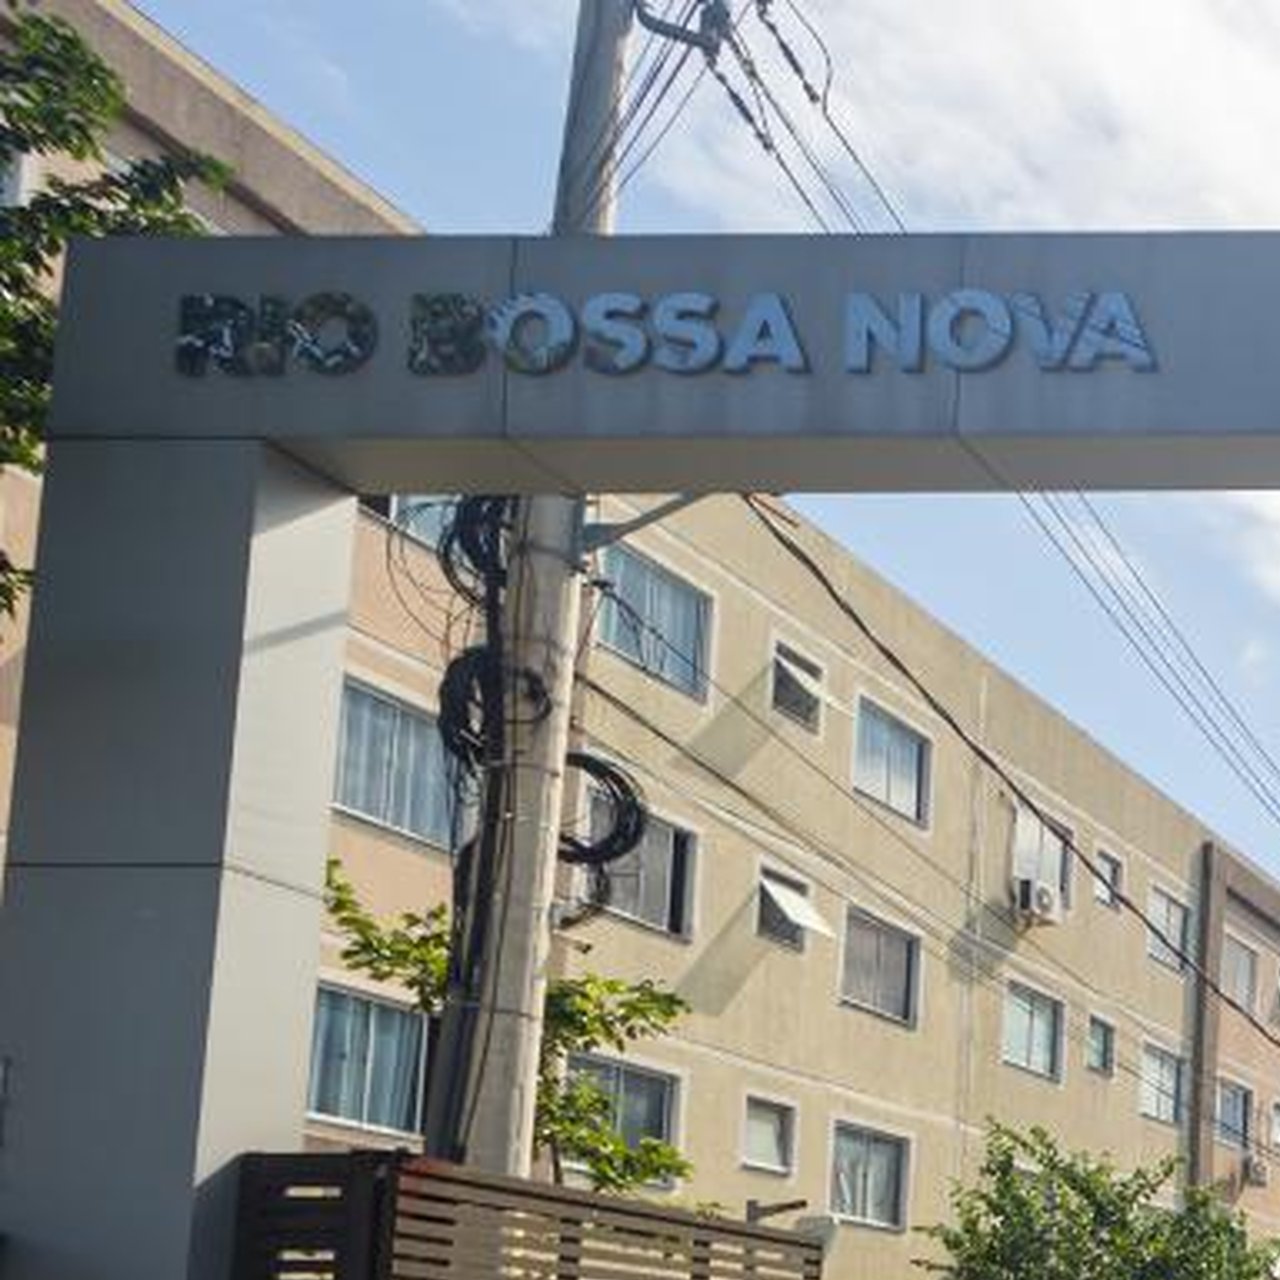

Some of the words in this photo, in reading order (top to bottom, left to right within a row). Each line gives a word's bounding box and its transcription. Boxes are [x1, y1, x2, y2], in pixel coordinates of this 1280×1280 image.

[174, 287, 380, 377] RIO
[406, 287, 814, 377] BOSSA
[840, 286, 1160, 375] NOVA
